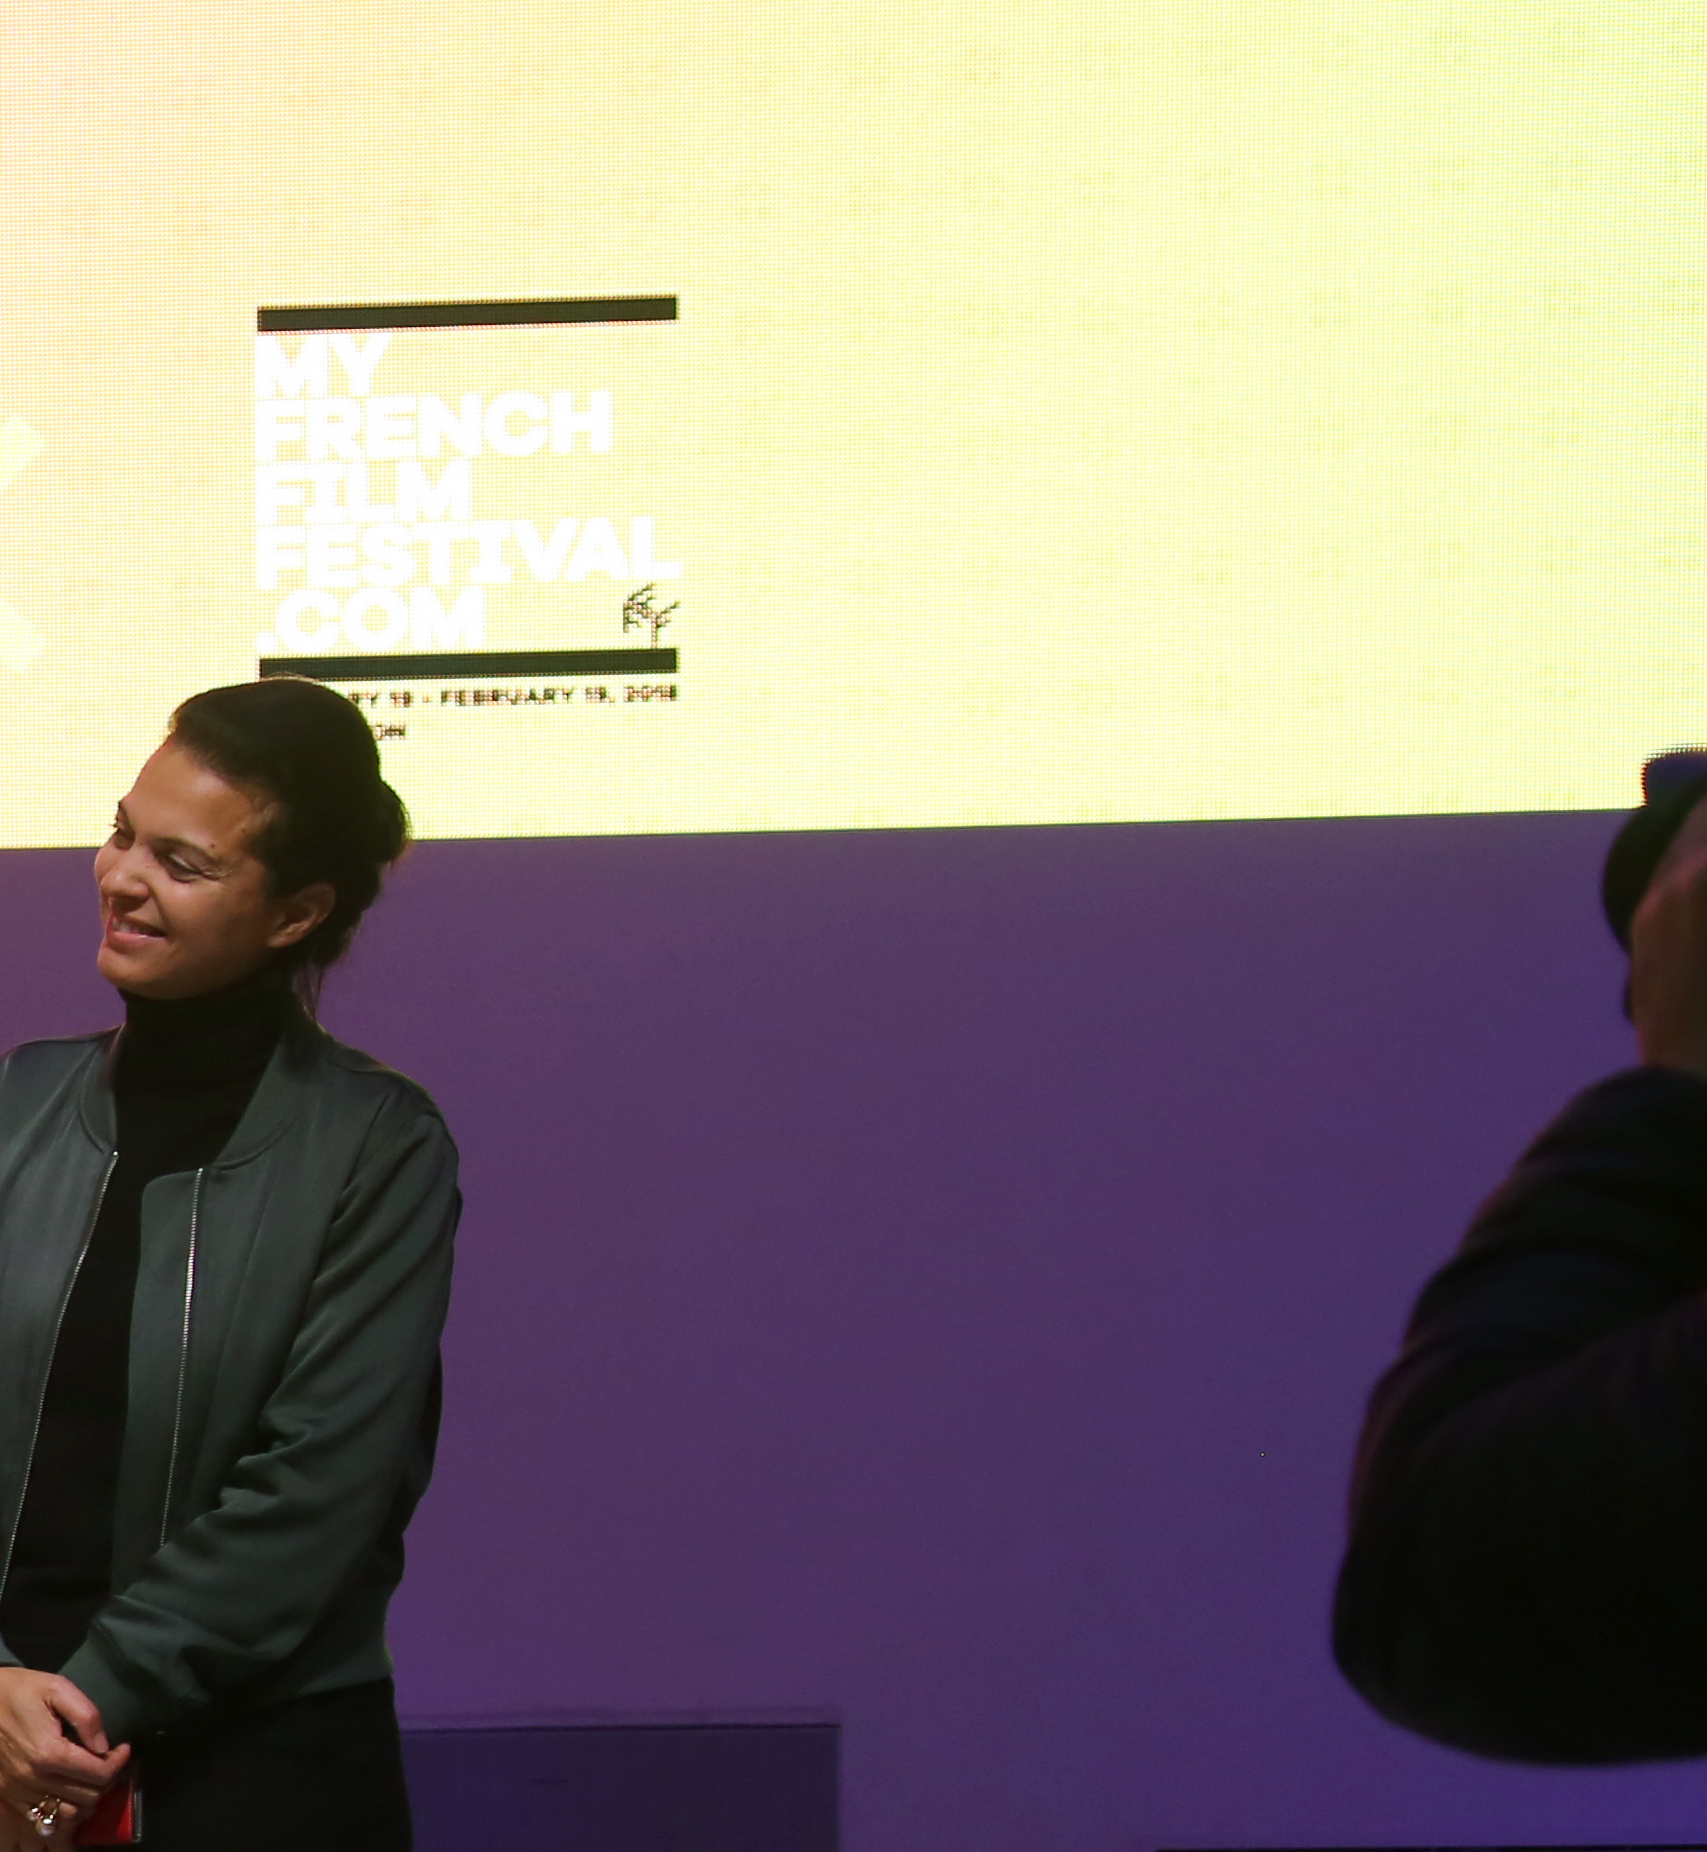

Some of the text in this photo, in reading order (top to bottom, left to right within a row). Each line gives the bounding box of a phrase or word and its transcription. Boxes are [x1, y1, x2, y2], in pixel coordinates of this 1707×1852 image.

[256, 334, 391, 397] MY
[256, 391, 614, 460] FRENCH
[256, 458, 473, 523] FILM
[256, 516, 683, 590] FESTIVAL
[440, 687, 573, 707] FEBRUARY
